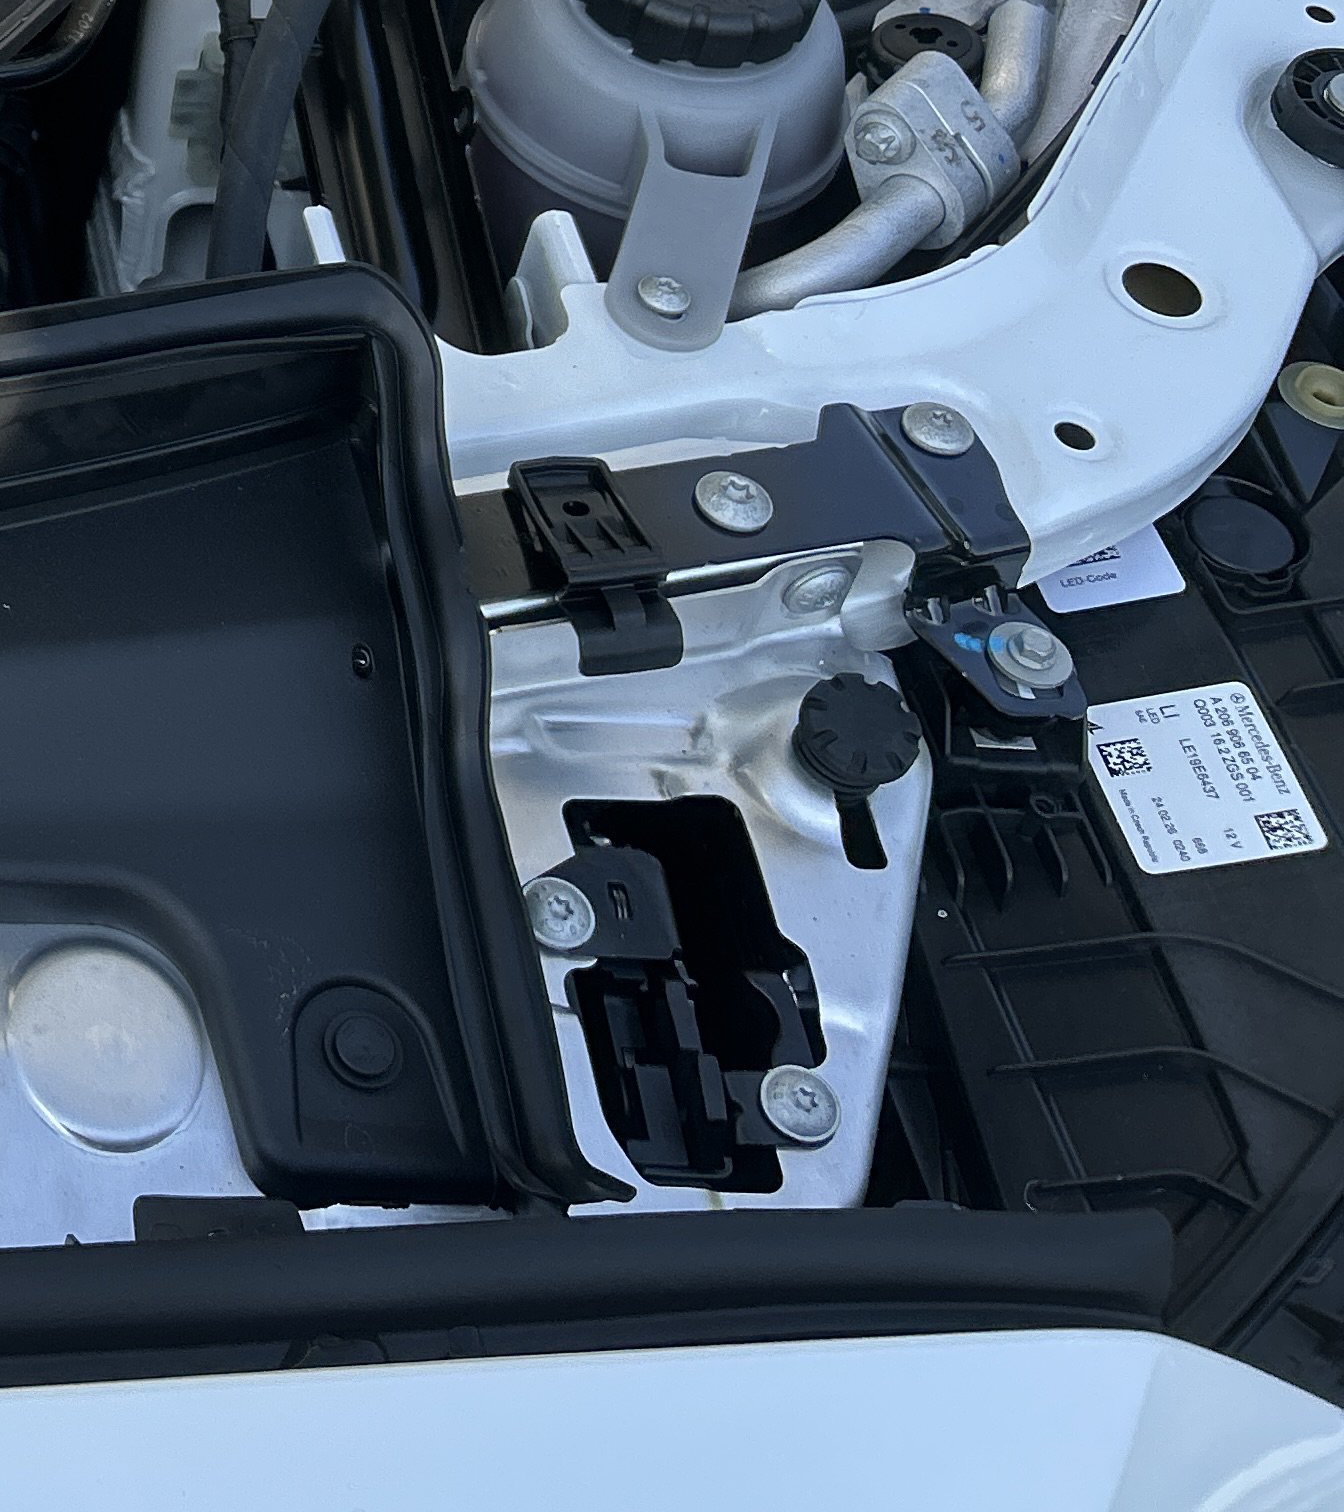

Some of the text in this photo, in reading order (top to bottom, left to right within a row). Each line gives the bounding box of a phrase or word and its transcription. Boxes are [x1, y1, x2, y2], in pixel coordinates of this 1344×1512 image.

[1208, 695, 1224, 704] A
[1214, 706, 1235, 726] 206
[1225, 728, 1247, 748] 906
[1191, 698, 1217, 727] Q003
[1220, 755, 1245, 781] ZGS
[1234, 781, 1255, 802] 001
[1234, 704, 1291, 795] Mercedes-Benz
[1244, 766, 1263, 781] 04
[1222, 827, 1243, 850] 12 V
